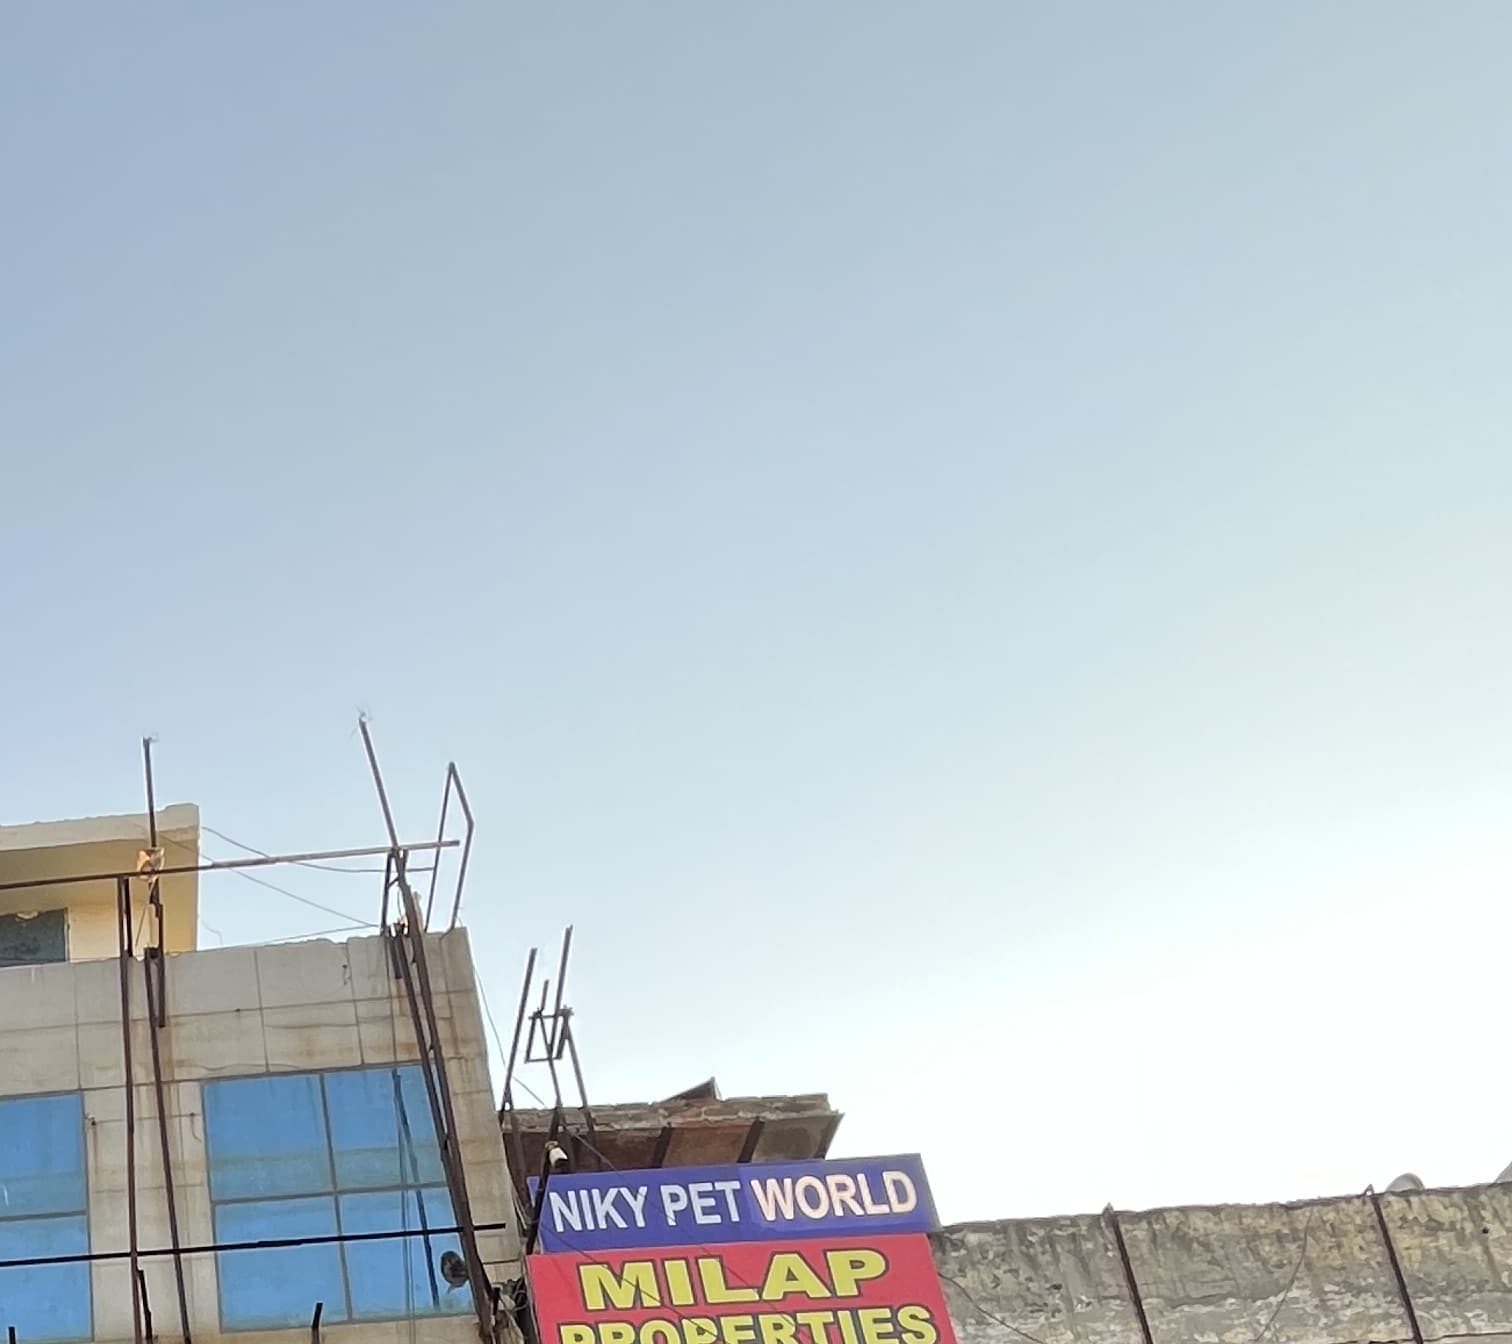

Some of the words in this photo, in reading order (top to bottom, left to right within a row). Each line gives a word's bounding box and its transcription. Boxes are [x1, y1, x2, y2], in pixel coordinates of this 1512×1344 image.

[549, 1185, 647, 1233] NIKY
[660, 1180, 741, 1226] PET
[750, 1170, 917, 1222] WORLD
[578, 1248, 888, 1312] MILAP
